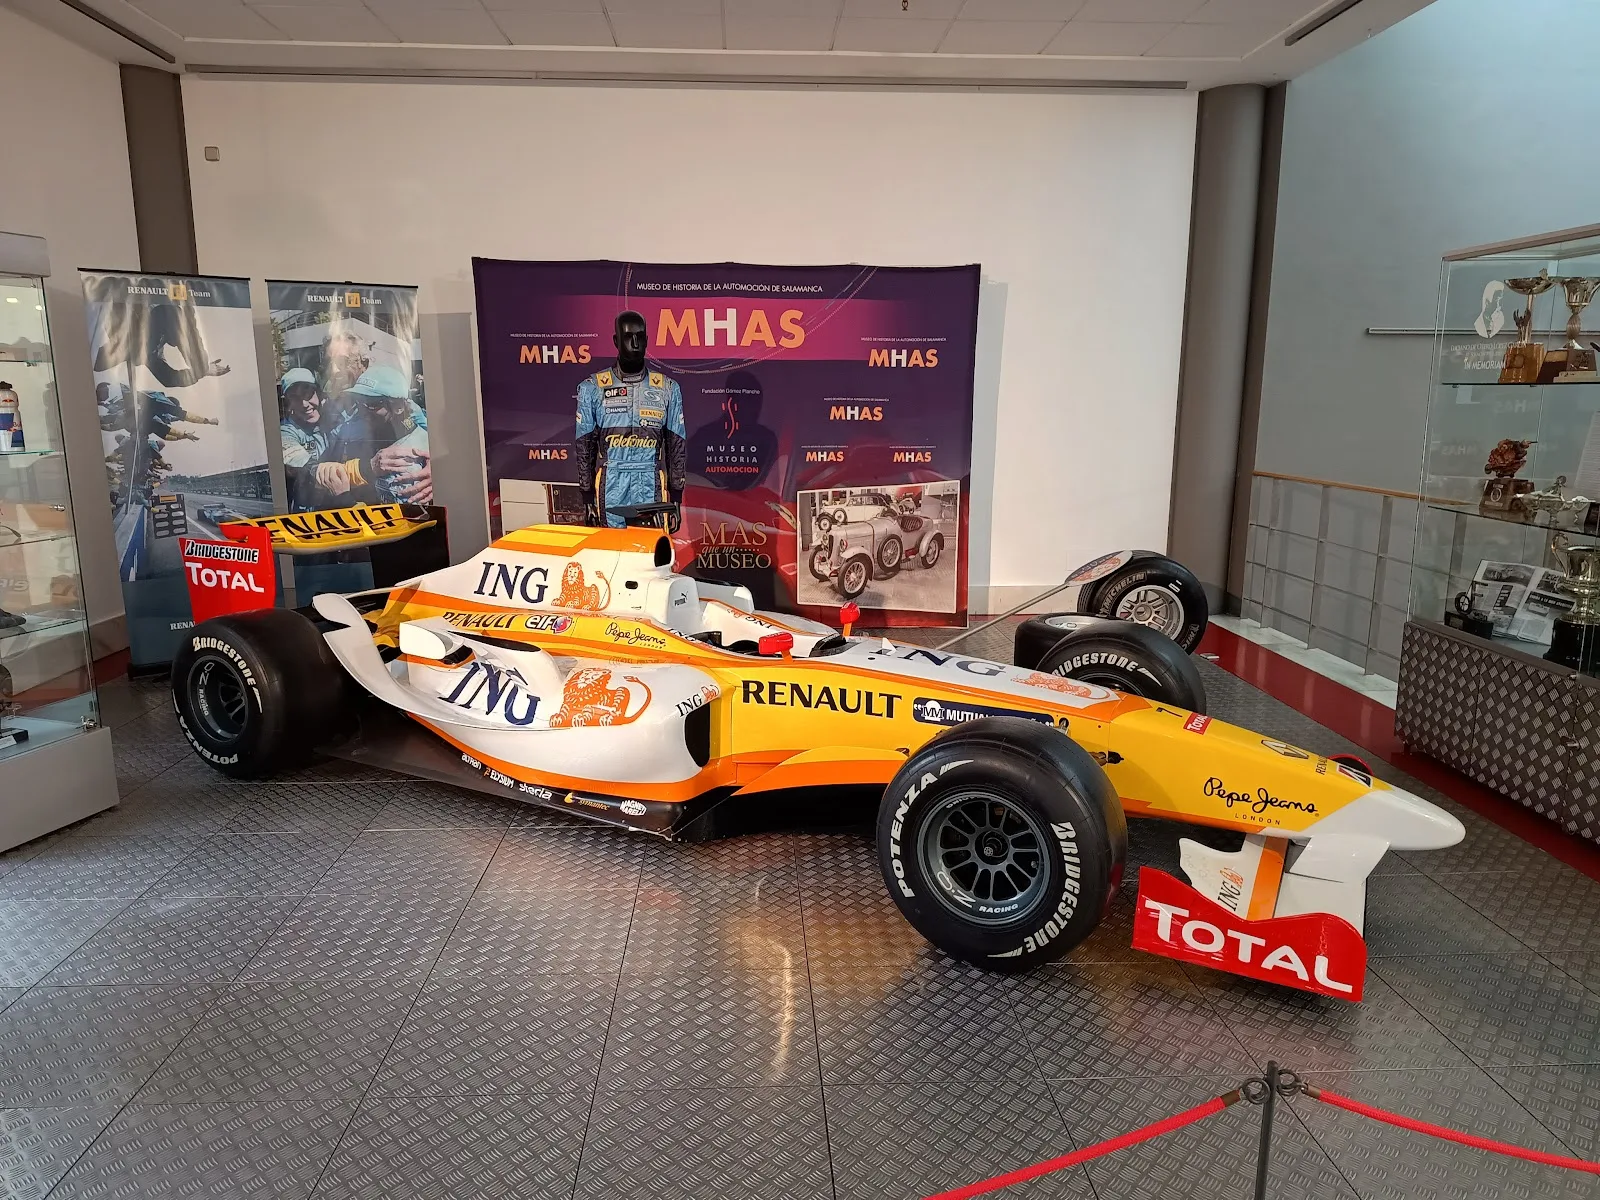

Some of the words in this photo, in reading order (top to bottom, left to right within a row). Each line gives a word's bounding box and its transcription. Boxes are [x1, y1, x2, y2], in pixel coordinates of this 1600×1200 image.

[127, 286, 169, 296] RENAULT
[188, 289, 211, 298] Team
[307, 294, 344, 303] RENAULT
[361, 296, 382, 305] Team
[636, 283, 662, 291] MUSEO
[722, 283, 770, 292] AUTOMOCIÓN
[781, 285, 823, 293] SALAMANCA
[655, 307, 806, 349] MHAS
[519, 344, 592, 364] MHAS
[868, 348, 939, 368] MHAS
[1472, 360, 1506, 370] MEMORIAM
[605, 388, 618, 397] elf
[829, 405, 883, 421] MHAS
[528, 449, 568, 460] MHAS
[706, 445, 757, 453] MUSEO
[805, 451, 845, 462] MHAS
[893, 452, 932, 463] MHAS
[705, 466, 759, 474] AUTOMOCION
[238, 505, 397, 543] ENAULT
[700, 521, 768, 546] MAS
[184, 540, 260, 564] BRIDGESTONE
[696, 553, 772, 569] MUSEO
[702, 545, 720, 557] que
[185, 561, 265, 593] TOTAL
[473, 561, 549, 604] ING
[1104, 572, 1147, 611] MICHELIN
[169, 620, 195, 631] RENA
[442, 611, 524, 630] RENAULT
[525, 614, 556, 632] elf
[605, 621, 632, 643] Pepe
[628, 627, 667, 648] Jeans
[192, 636, 257, 686] BRIDGESTONE
[868, 645, 1007, 677] ING
[1052, 652, 1140, 677] RIDGESTONE
[438, 661, 541, 726] ING
[675, 692, 703, 718] ING
[741, 679, 903, 719] RENAULT
[178, 715, 239, 765] POTENZA
[490, 769, 515, 789] ELYSIUM
[519, 782, 553, 801] steria
[578, 798, 611, 811] symantec
[1203, 776, 1253, 808] Pepe
[1251, 787, 1319, 814] Jeans
[1234, 813, 1281, 826] LONDON
[890, 771, 938, 898] POTENZA
[1023, 821, 1082, 954] BRIDGESTONE
[1217, 880, 1241, 912] ING
[978, 903, 1019, 914] RACING
[1144, 899, 1353, 994] TOTAL
